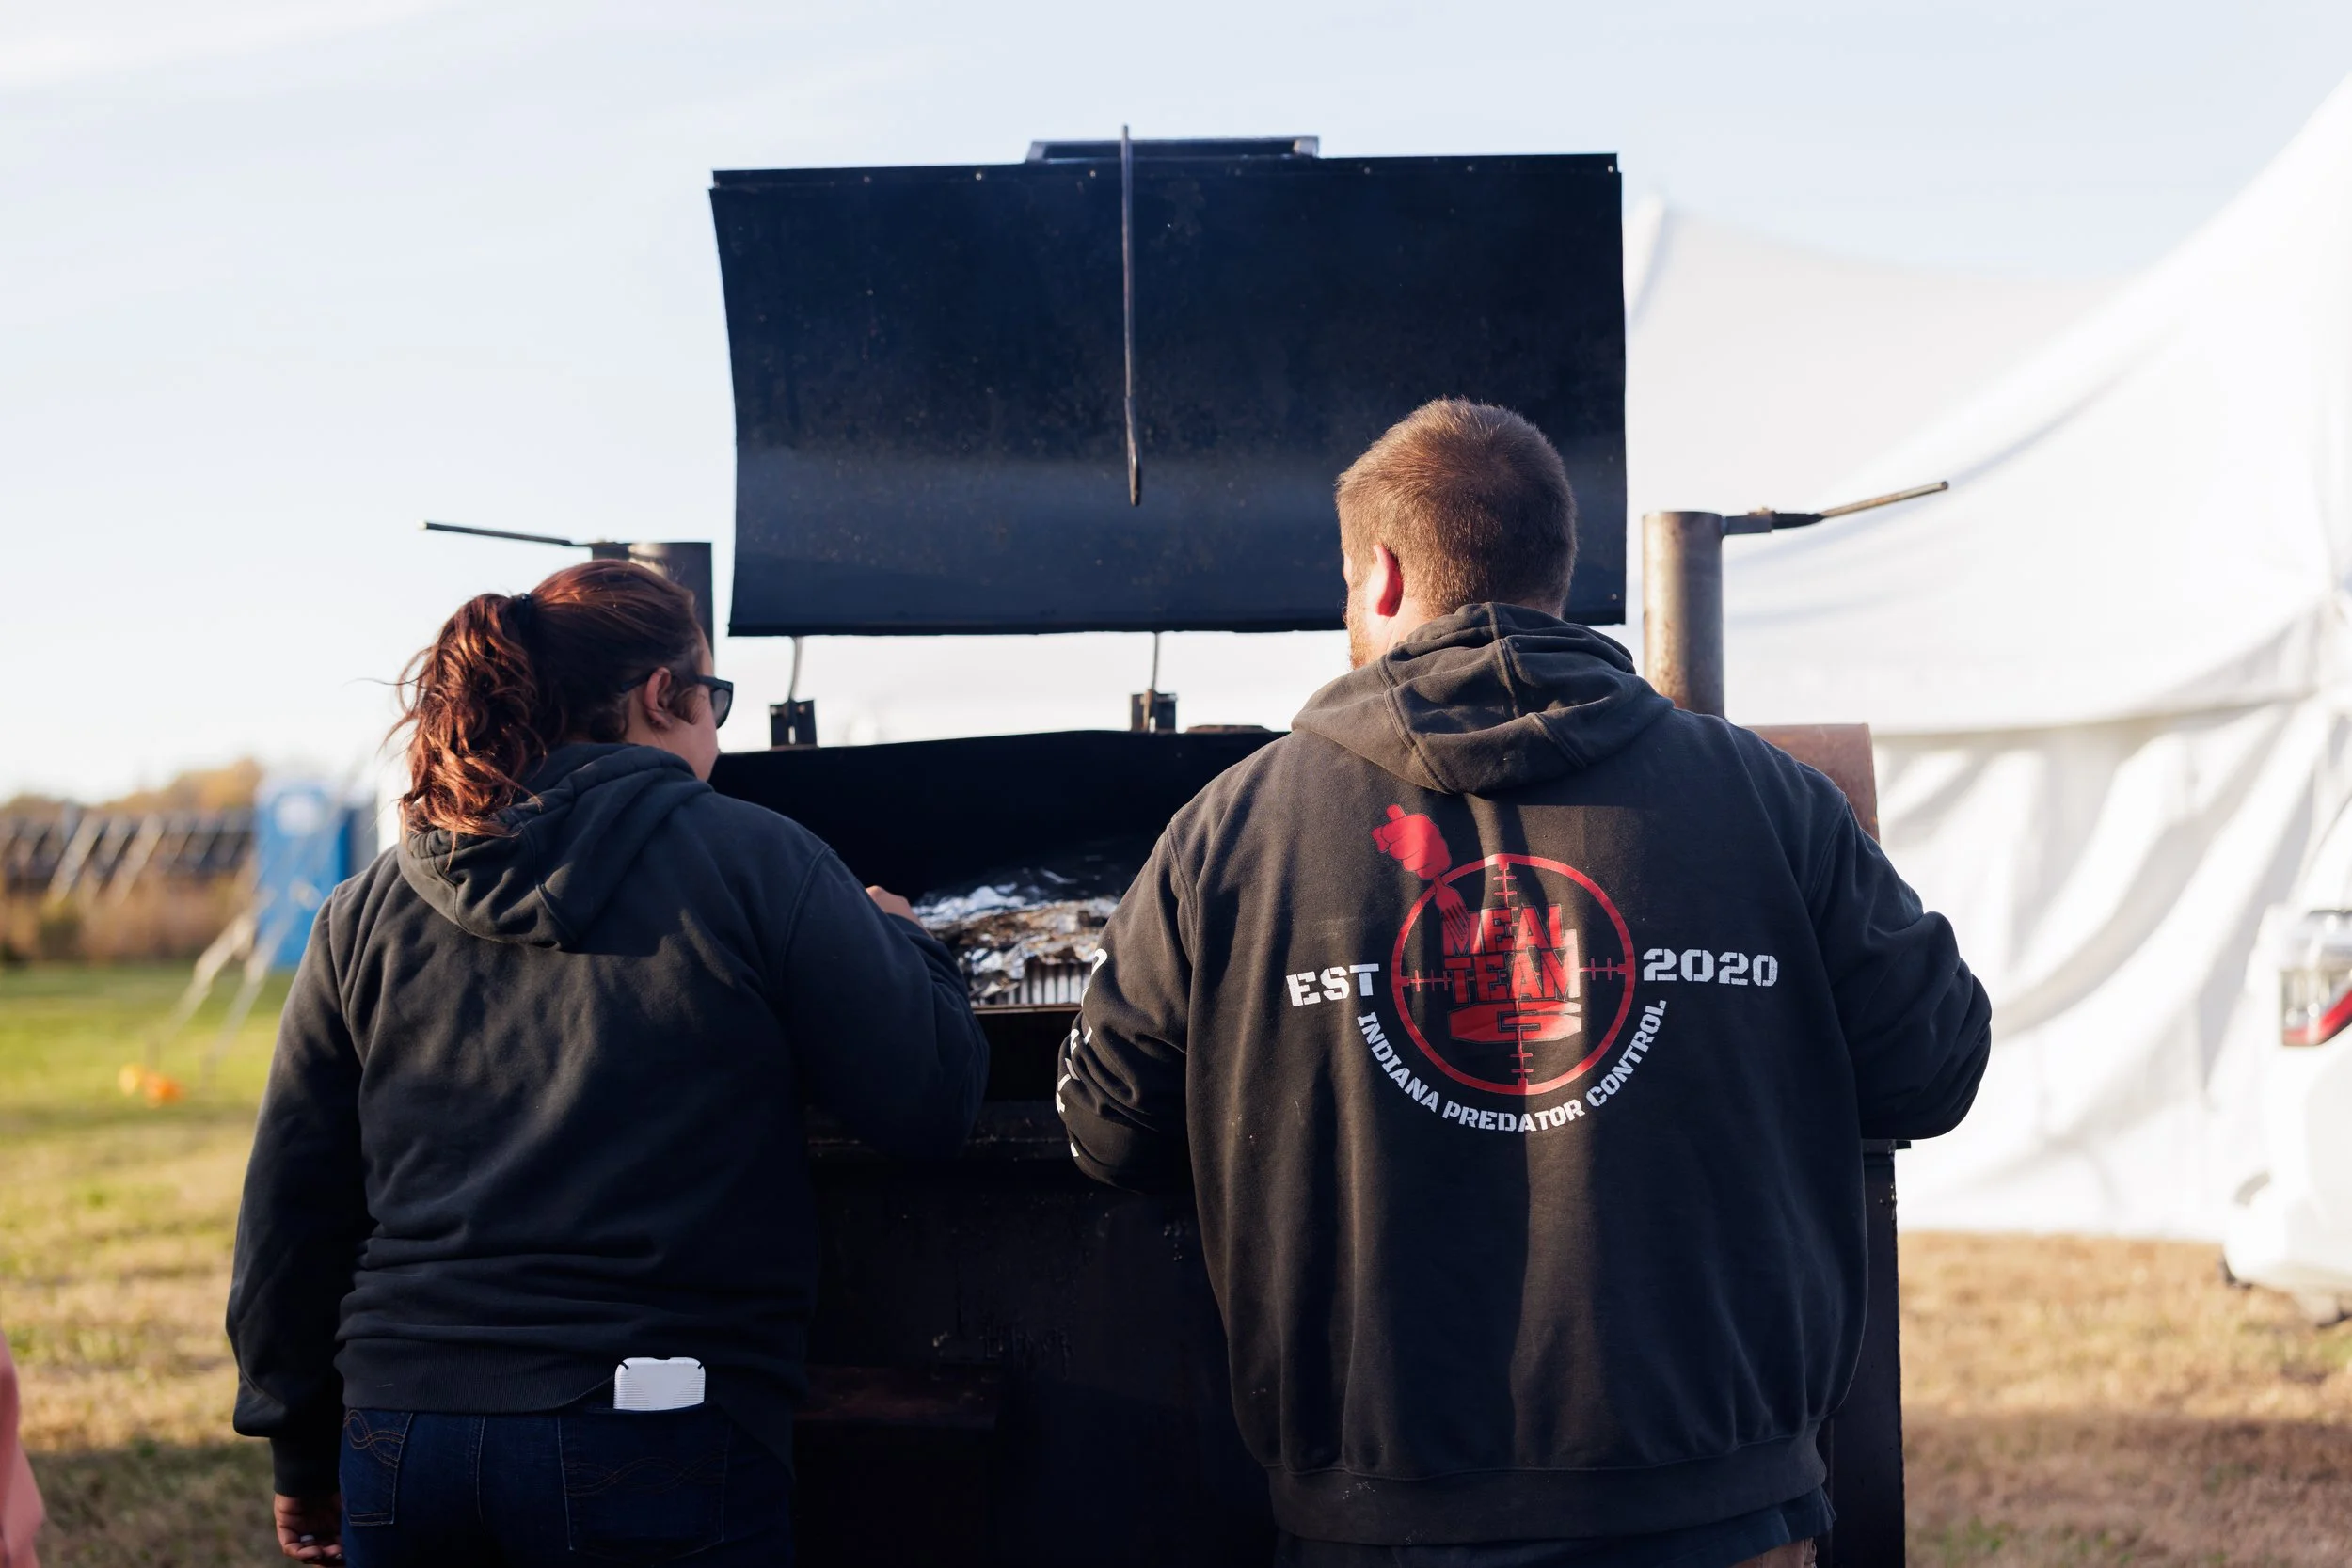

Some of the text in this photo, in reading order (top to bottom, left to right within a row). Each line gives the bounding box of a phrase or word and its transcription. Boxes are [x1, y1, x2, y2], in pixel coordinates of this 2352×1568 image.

[1442, 904, 1577, 957] MEAL
[1285, 948, 1778, 1006] EST 2020
[1444, 949, 1581, 1004] TEAM
[1357, 1000, 1667, 1132] INDIANA PREDATOR CONTROL
